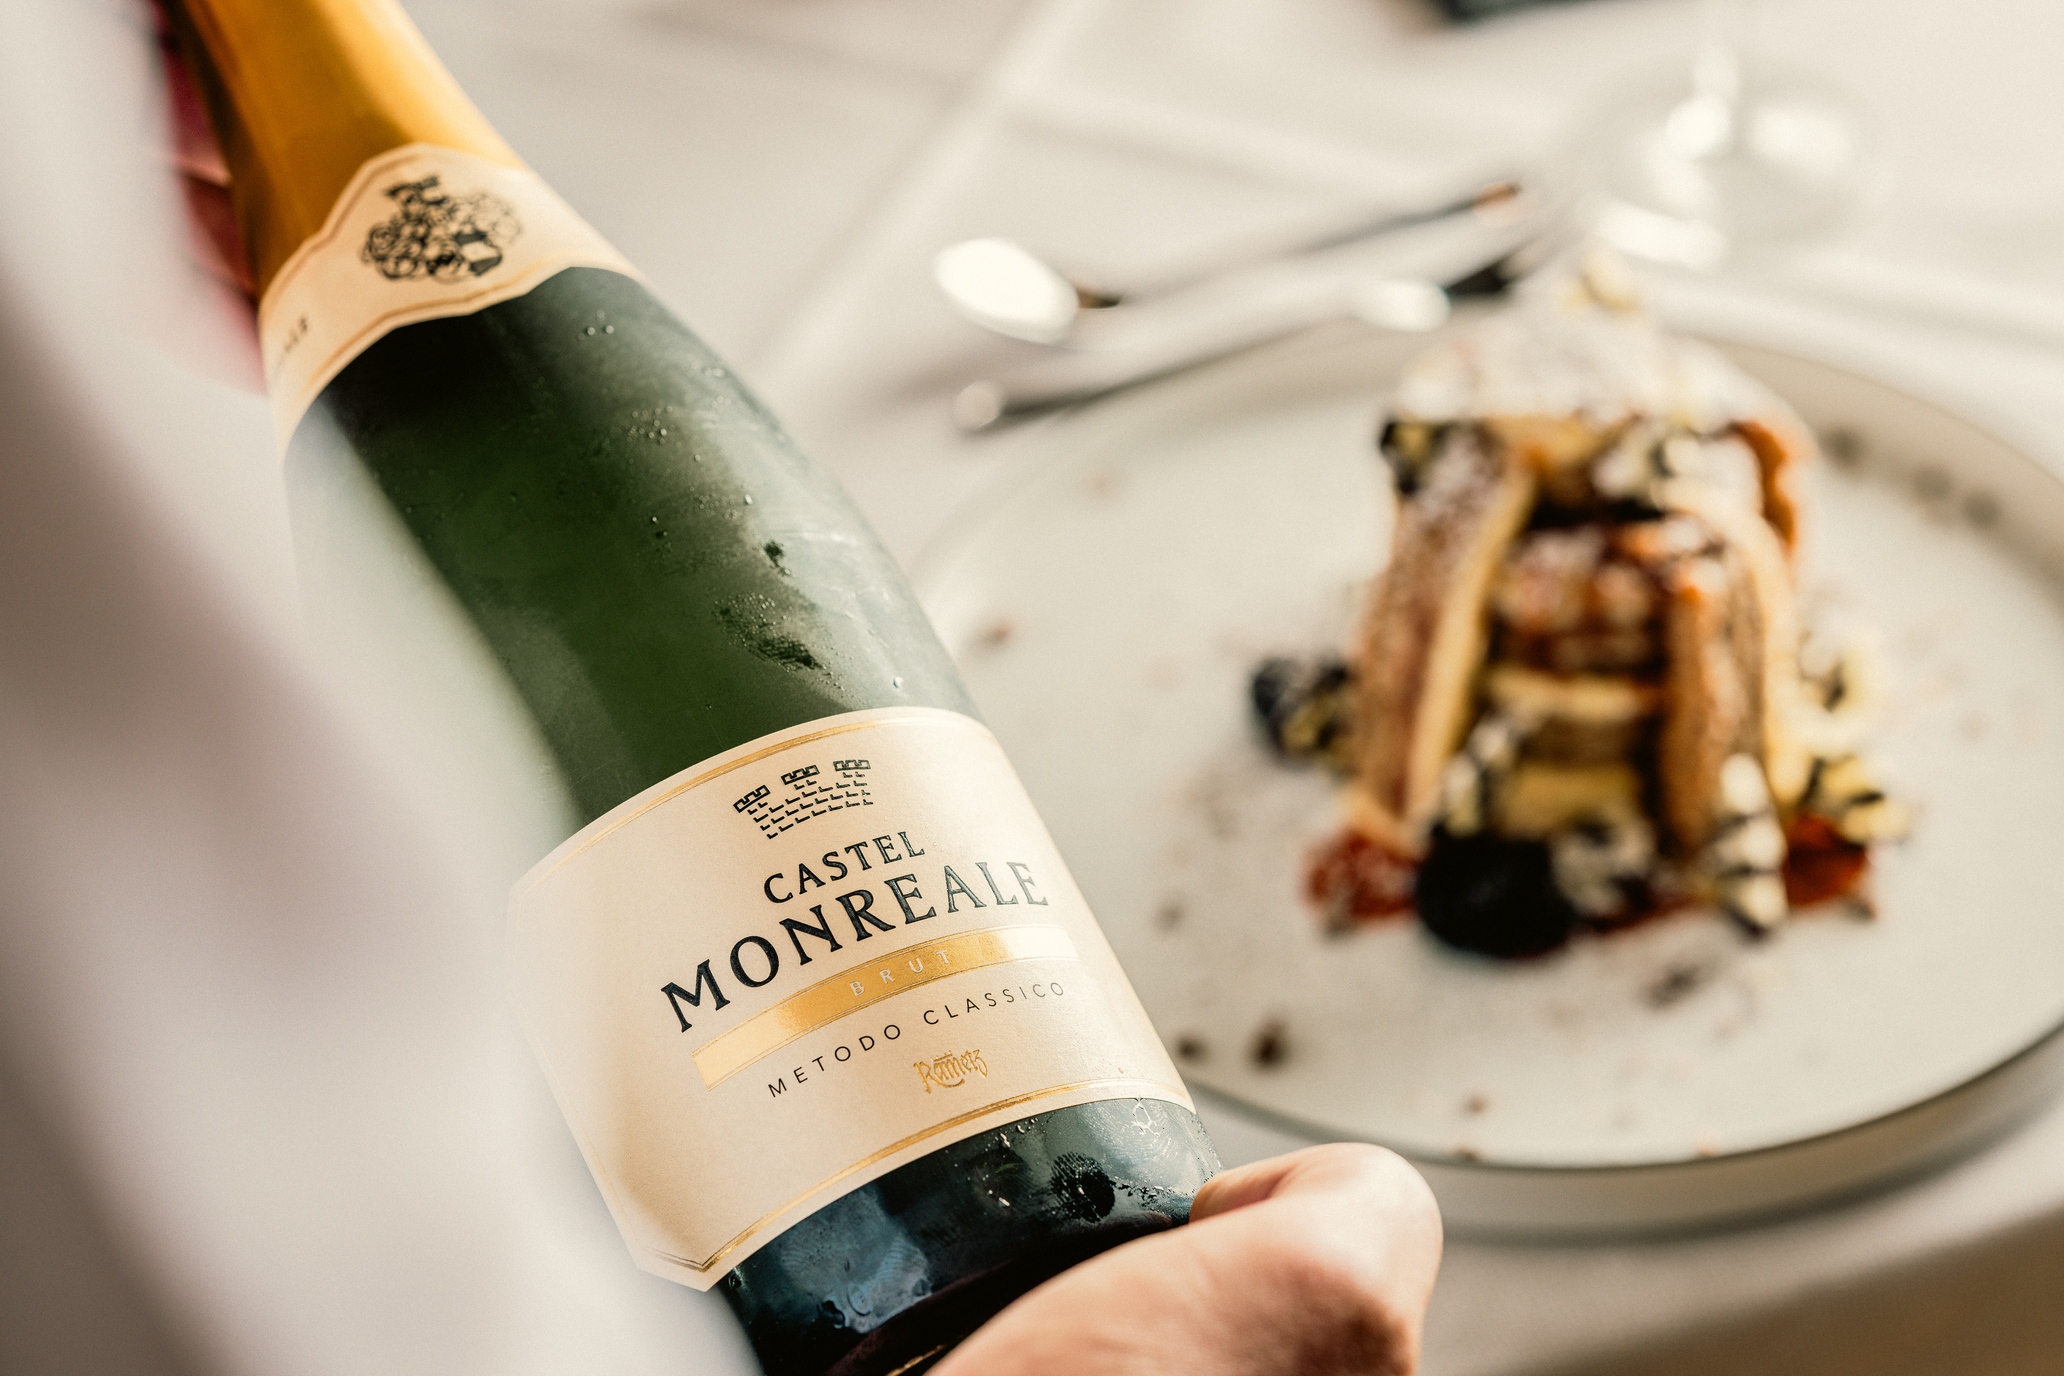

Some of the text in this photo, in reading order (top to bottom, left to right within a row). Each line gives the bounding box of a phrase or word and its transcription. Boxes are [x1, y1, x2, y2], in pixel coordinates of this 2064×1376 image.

[763, 831, 925, 904] CASTEL
[660, 861, 1049, 1033] MONREALE
[849, 949, 949, 997] BRUT
[767, 982, 1065, 1098] METODO CLASSICO
